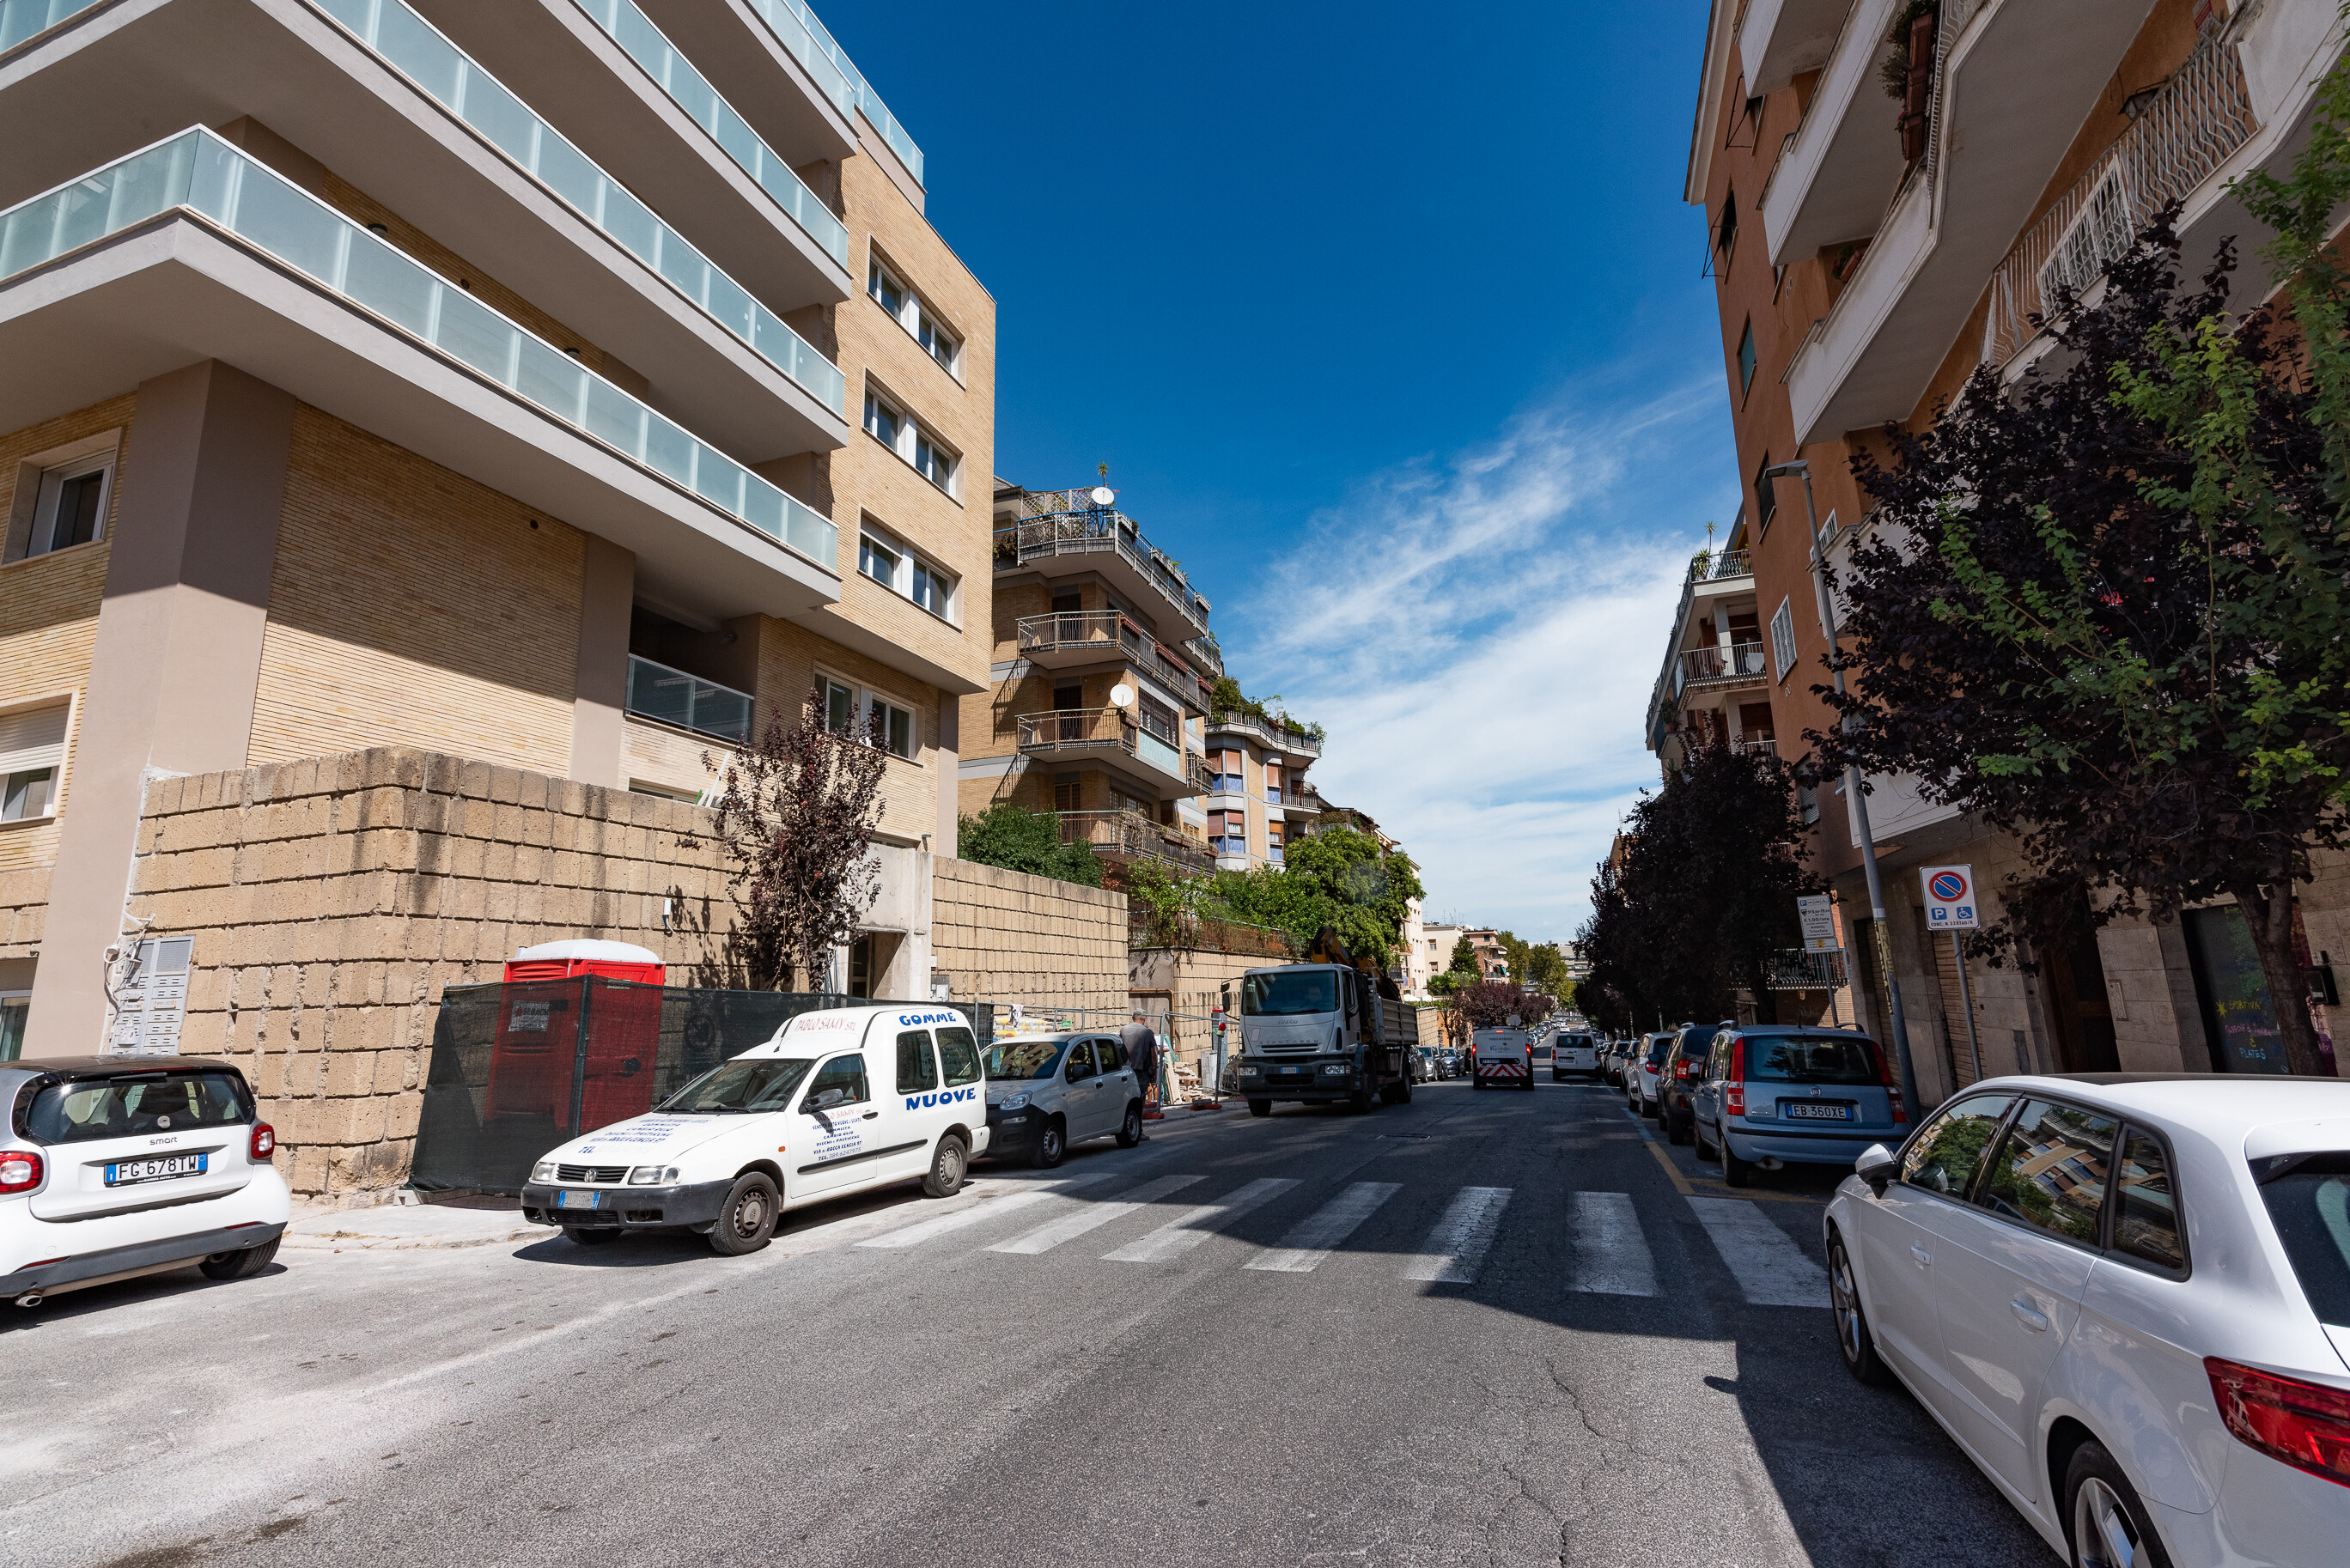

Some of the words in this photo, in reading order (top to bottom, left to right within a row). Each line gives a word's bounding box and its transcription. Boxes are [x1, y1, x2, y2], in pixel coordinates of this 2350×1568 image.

[899, 1012, 957, 1026] GOMME
[2239, 1048, 2267, 1060] PILATES
[906, 1087, 977, 1110] NUOVE
[1793, 1105, 1807, 1116] EB
[1811, 1106, 1846, 1118] 360XE
[149, 1136, 178, 1146] smart
[119, 1163, 140, 1179] FG
[147, 1156, 197, 1175] 678TW
